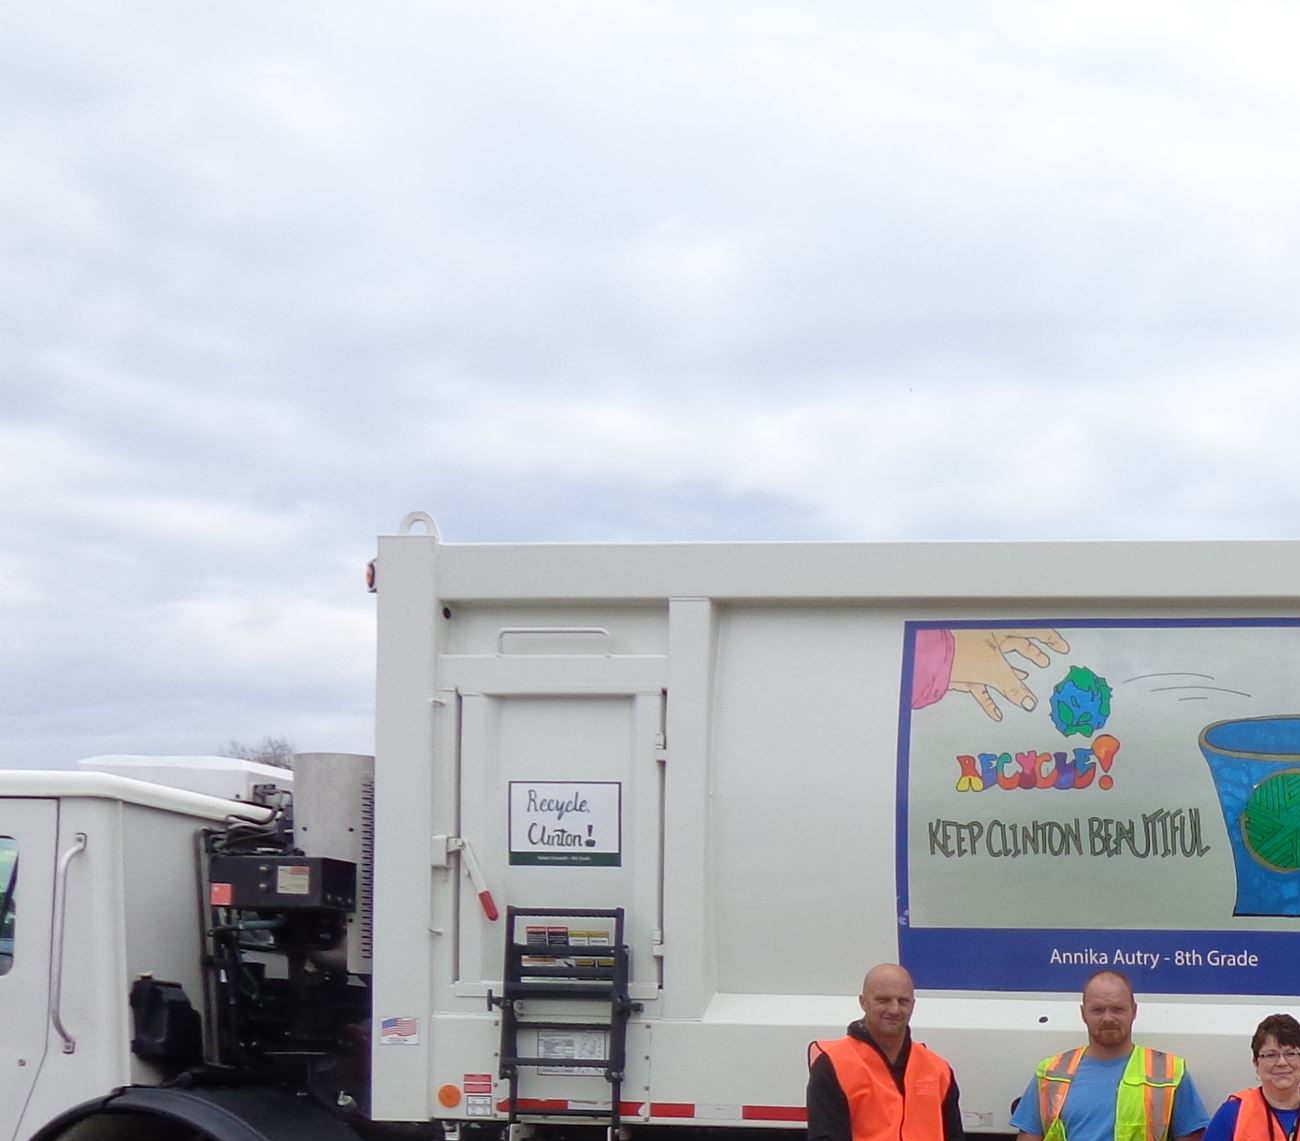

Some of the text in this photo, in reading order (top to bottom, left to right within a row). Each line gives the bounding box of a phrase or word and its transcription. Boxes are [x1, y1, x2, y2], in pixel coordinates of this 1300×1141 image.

[956, 734, 1120, 792] RECYCLE!
[527, 822, 597, 848] Clinton!
[928, 807, 1212, 859] KEEP CLINTON BEAUTIFUL
[1050, 949, 1109, 965] Annika
[1113, 949, 1160, 969] Autry
[1174, 950, 1203, 966] 8th
[1207, 950, 1259, 967] Grade
